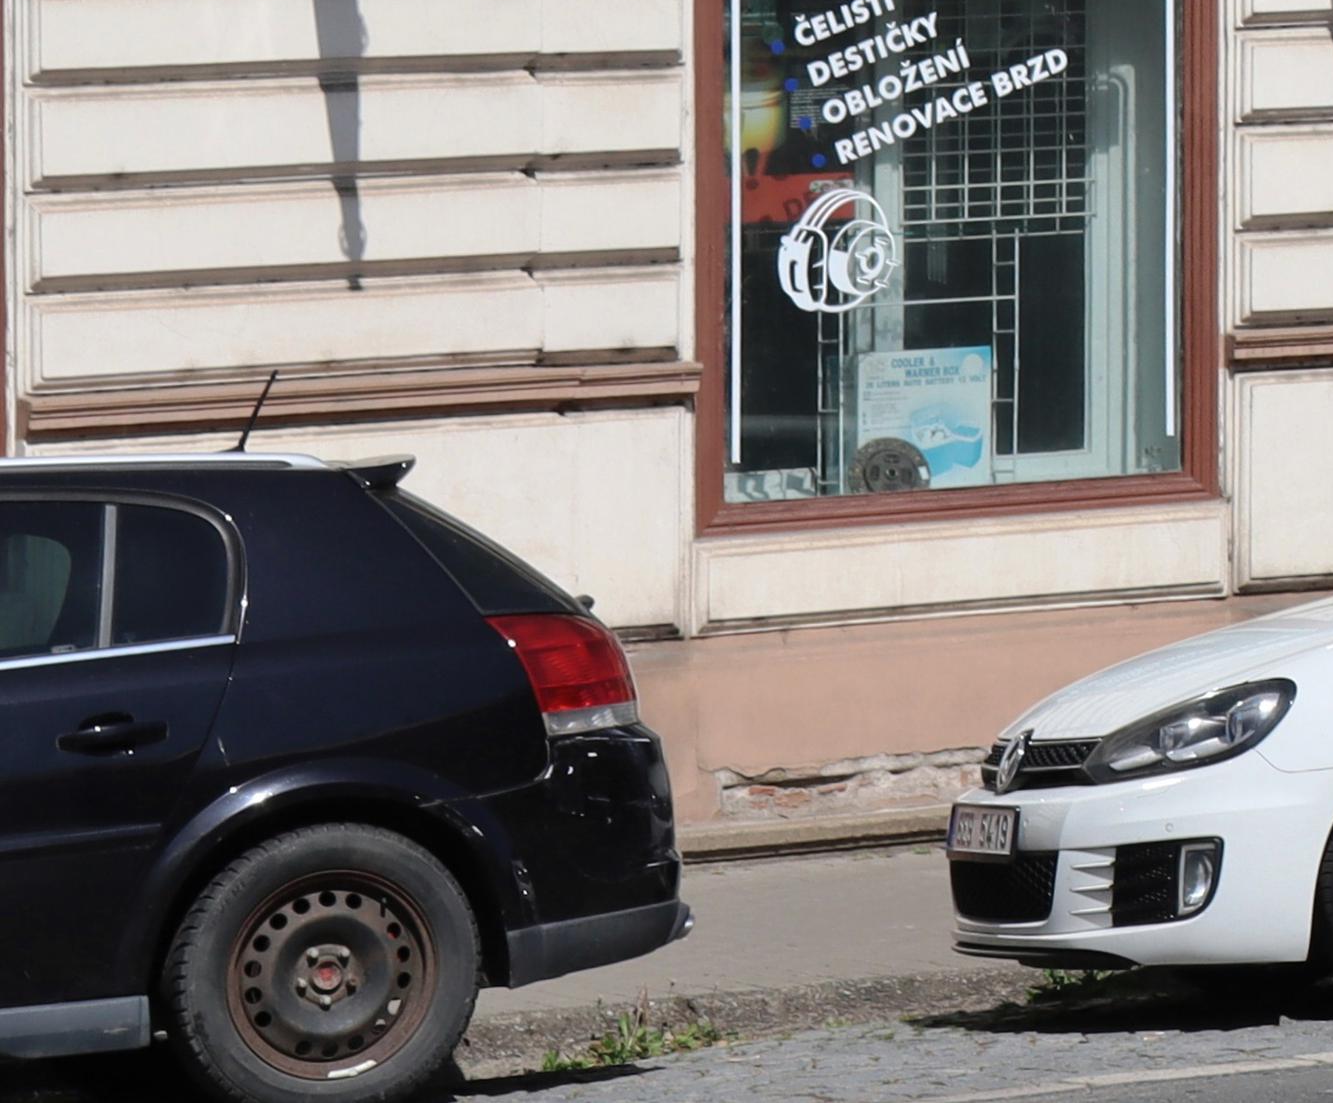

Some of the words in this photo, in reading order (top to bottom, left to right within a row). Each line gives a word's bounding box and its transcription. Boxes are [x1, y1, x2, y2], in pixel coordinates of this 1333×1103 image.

[806, 11, 938, 88] DESTIČKY
[822, 37, 971, 124] OBLOŽENÍ
[833, 84, 988, 165] RENOVACE
[990, 48, 1069, 99] BRZD
[890, 356, 925, 369] COOLER
